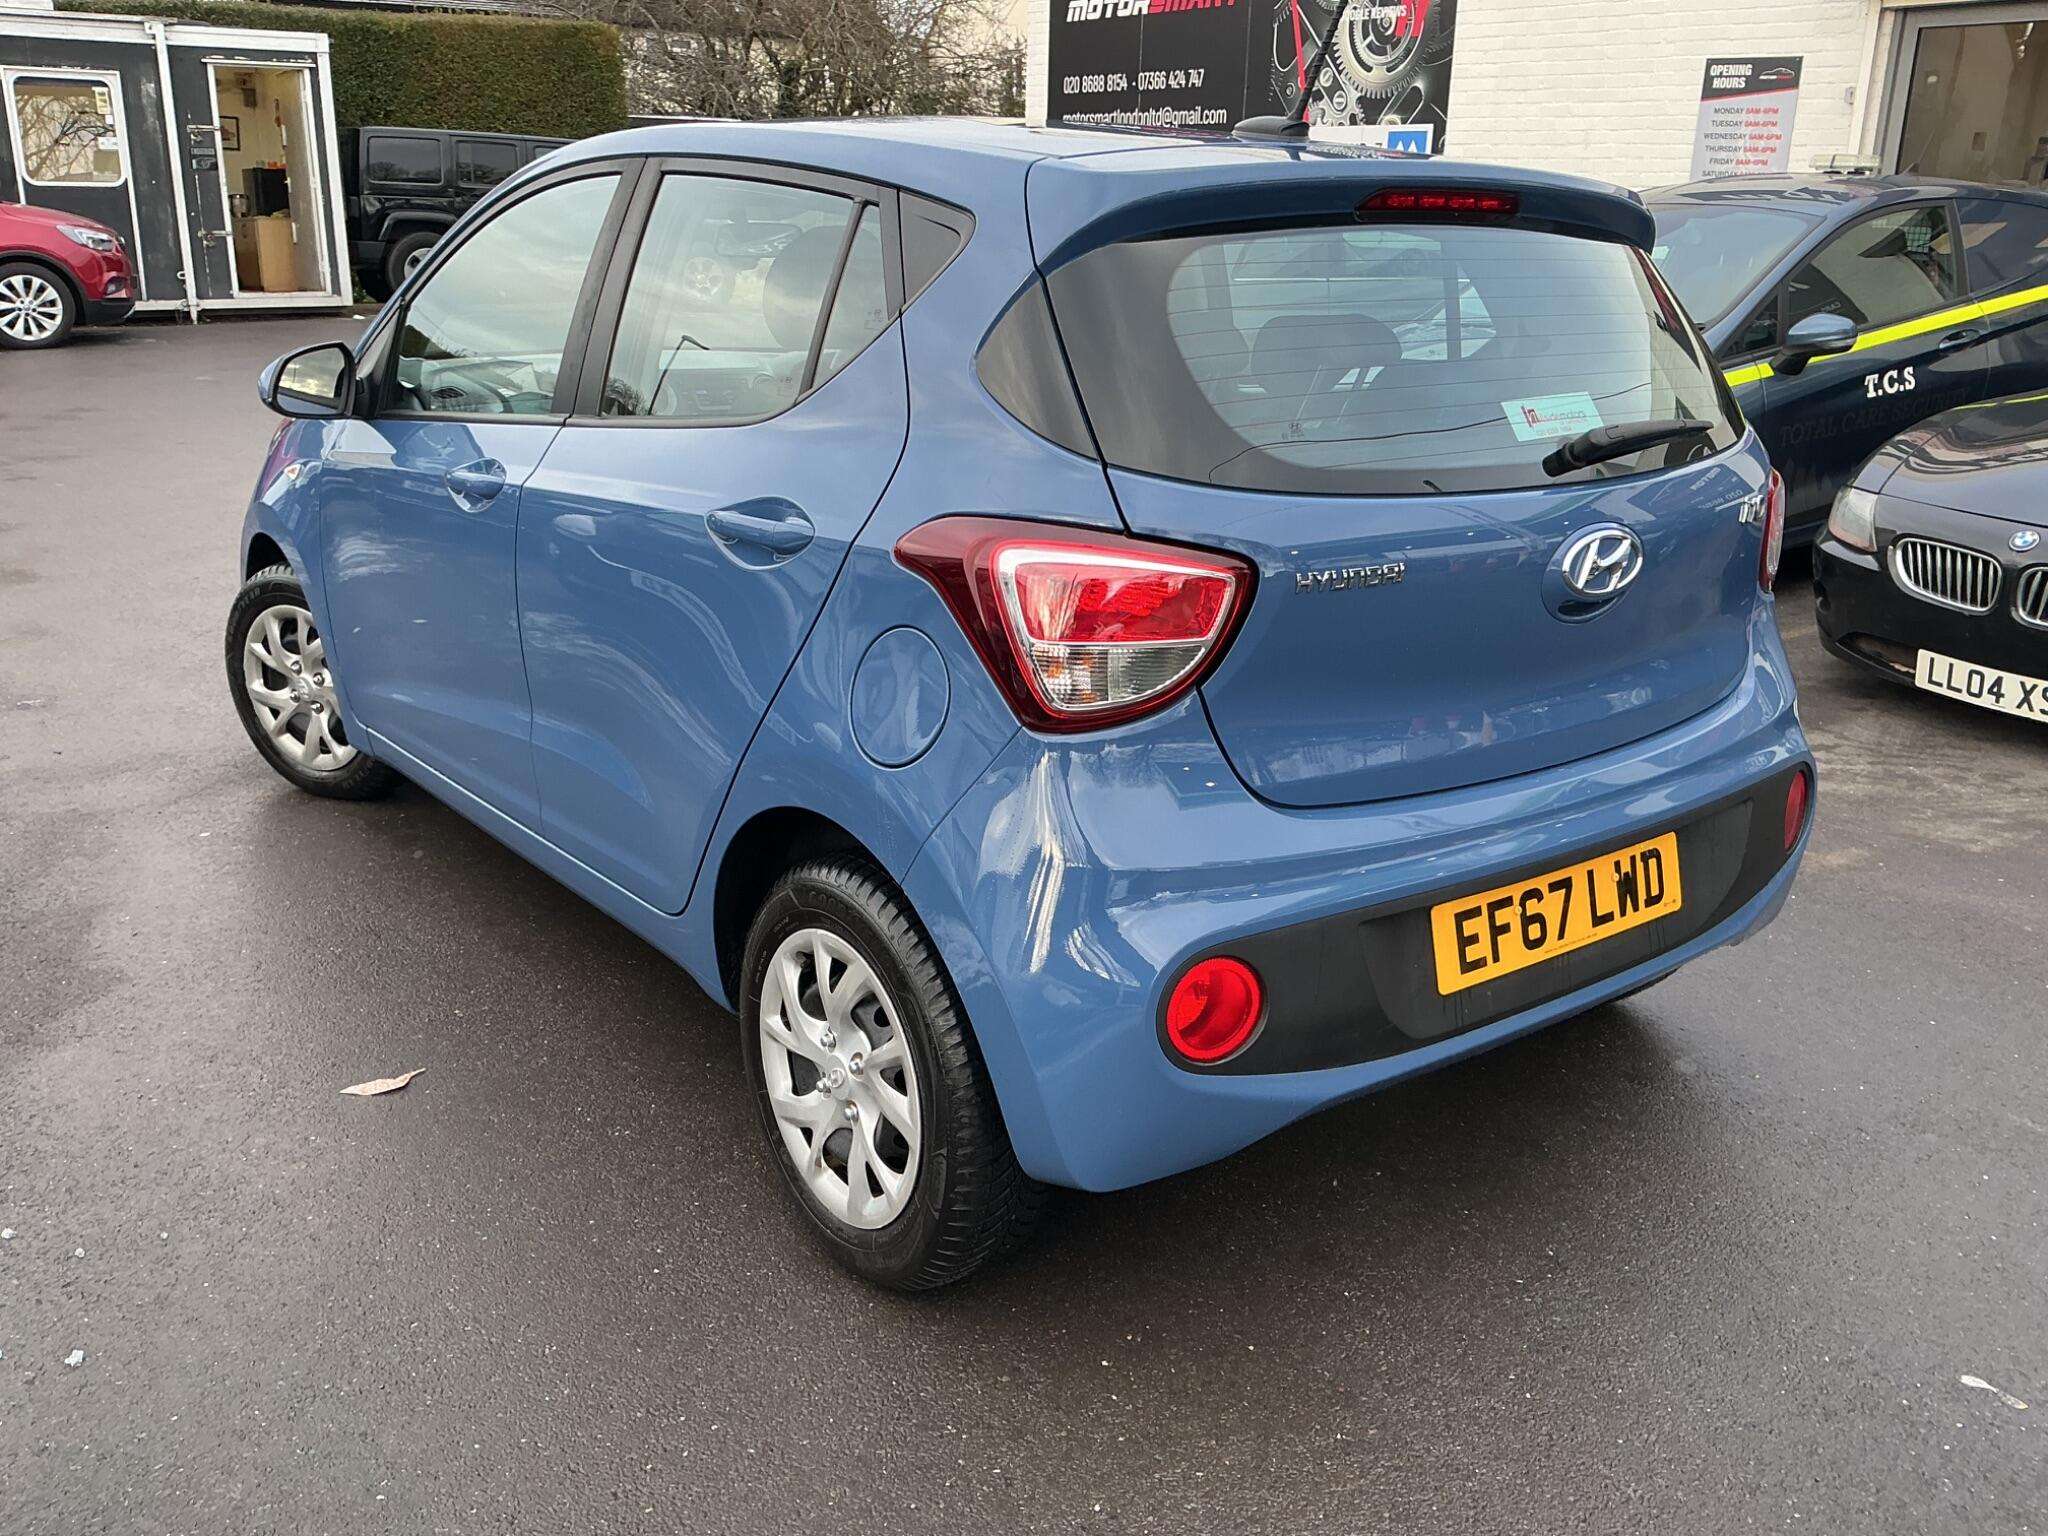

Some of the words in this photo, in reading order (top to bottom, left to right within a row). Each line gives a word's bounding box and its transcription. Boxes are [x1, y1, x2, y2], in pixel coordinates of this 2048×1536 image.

[1066, 0, 1236, 22] MOTORSM
[1063, 76, 1080, 94] 020
[1081, 74, 1105, 93] 8688
[1106, 73, 1128, 92] 8154
[1138, 71, 1167, 91] 07366
[1168, 69, 1186, 89] 424
[1187, 68, 1205, 88] 747
[1710, 64, 1753, 76] OPENING
[1712, 77, 1746, 89] HOURS
[1714, 107, 1744, 115] MONDAY
[1705, 145, 1742, 153] THURSDAY
[1864, 366, 1916, 398] T.C.S
[1295, 562, 1405, 594] HYUNDAI
[1927, 656, 2005, 704] LL04
[1454, 876, 1573, 975] EF67
[1587, 847, 1665, 928] LWD
